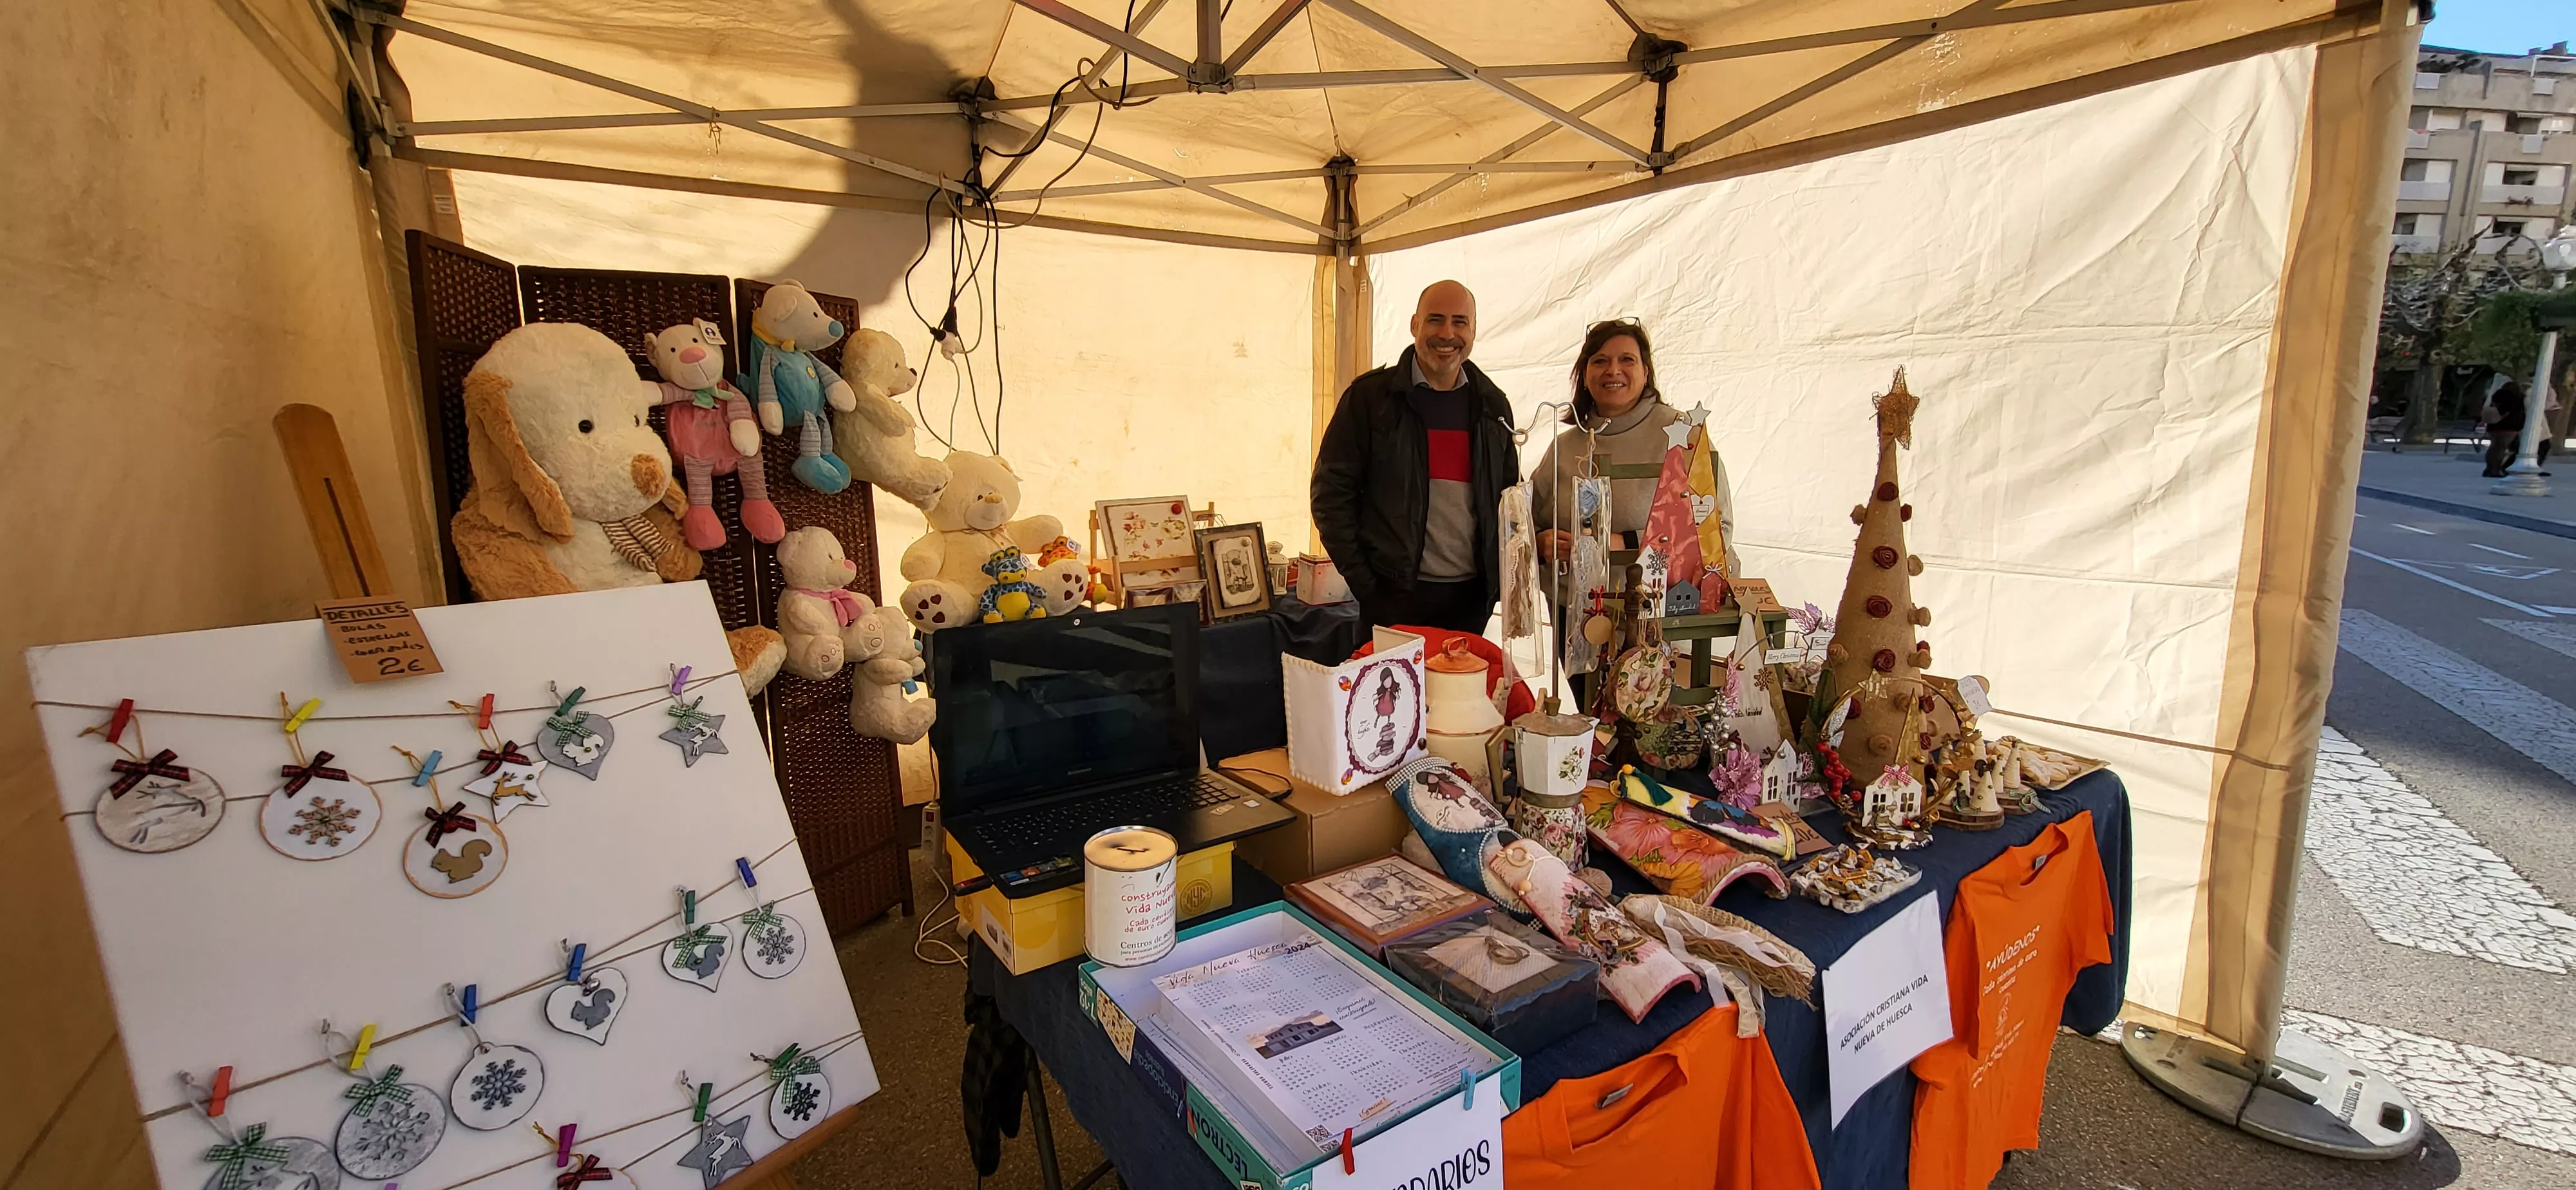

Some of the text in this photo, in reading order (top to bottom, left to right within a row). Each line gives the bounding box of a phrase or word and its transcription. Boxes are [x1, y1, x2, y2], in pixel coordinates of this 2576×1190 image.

[324, 604, 409, 620] DETALLES
[1126, 903, 1151, 914] Vida
[1186, 885, 1206, 912] NYC
[1130, 918, 1149, 927] Cada
[1121, 941, 1152, 950] Centros
[1202, 957, 1241, 976] Nueva
[1247, 941, 1287, 960] Huesca
[1284, 941, 1311, 954] 2024
[1840, 974, 1929, 1051] ASOCIACIÓN CRISTIANA VIDA
[1854, 1003, 1913, 1055] NUEVA DE HUESCA
[1191, 1107, 1249, 1180] LECTRON
